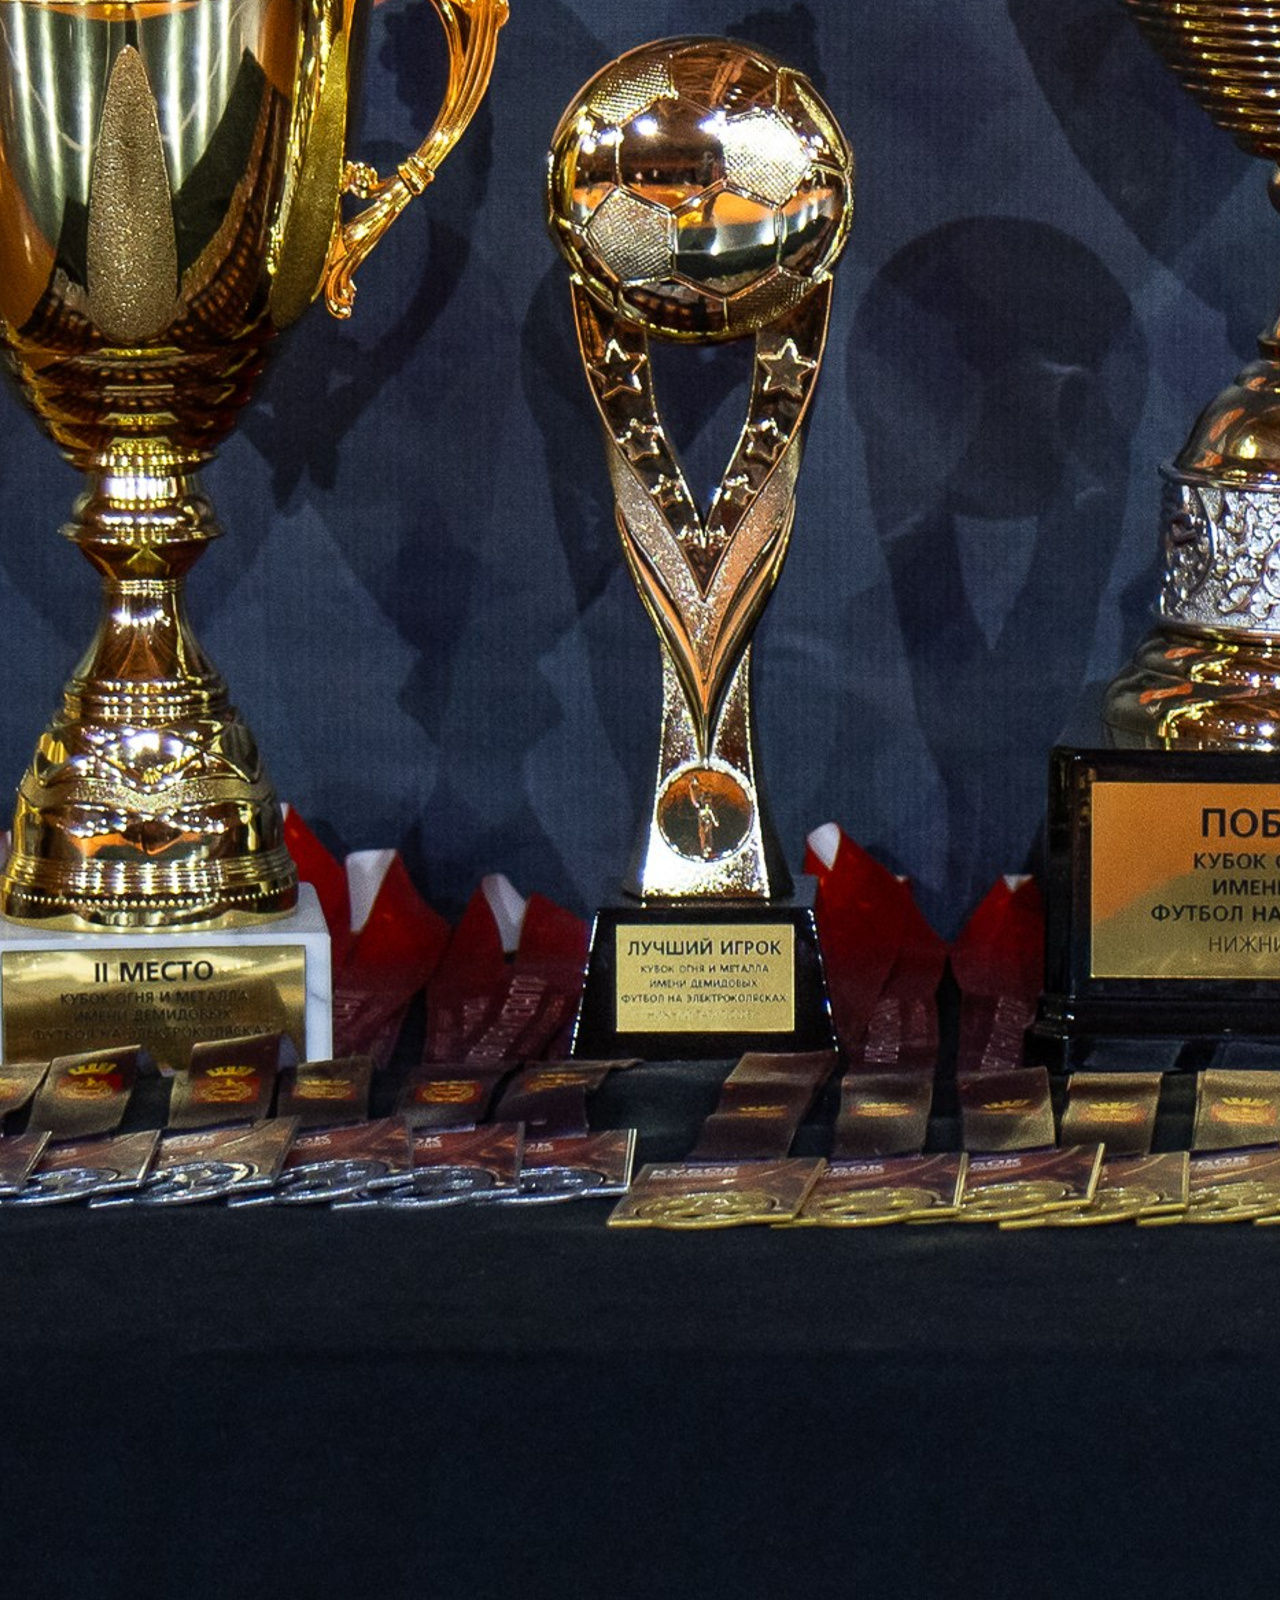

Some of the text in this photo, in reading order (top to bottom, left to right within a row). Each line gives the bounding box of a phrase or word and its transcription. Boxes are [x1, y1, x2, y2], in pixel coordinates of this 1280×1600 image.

[1193, 852, 1267, 870] КУБОК
[1151, 903, 1243, 922] ФУТБОЛ
[627, 937, 782, 956] ЛУЧШИЙ ИГРОК
[94, 960, 214, 983] II МЕСТО
[640, 964, 769, 974] КУБОК ОГНЯ И МЕТАЛЛА
[649, 979, 687, 988] ИМЕНИ
